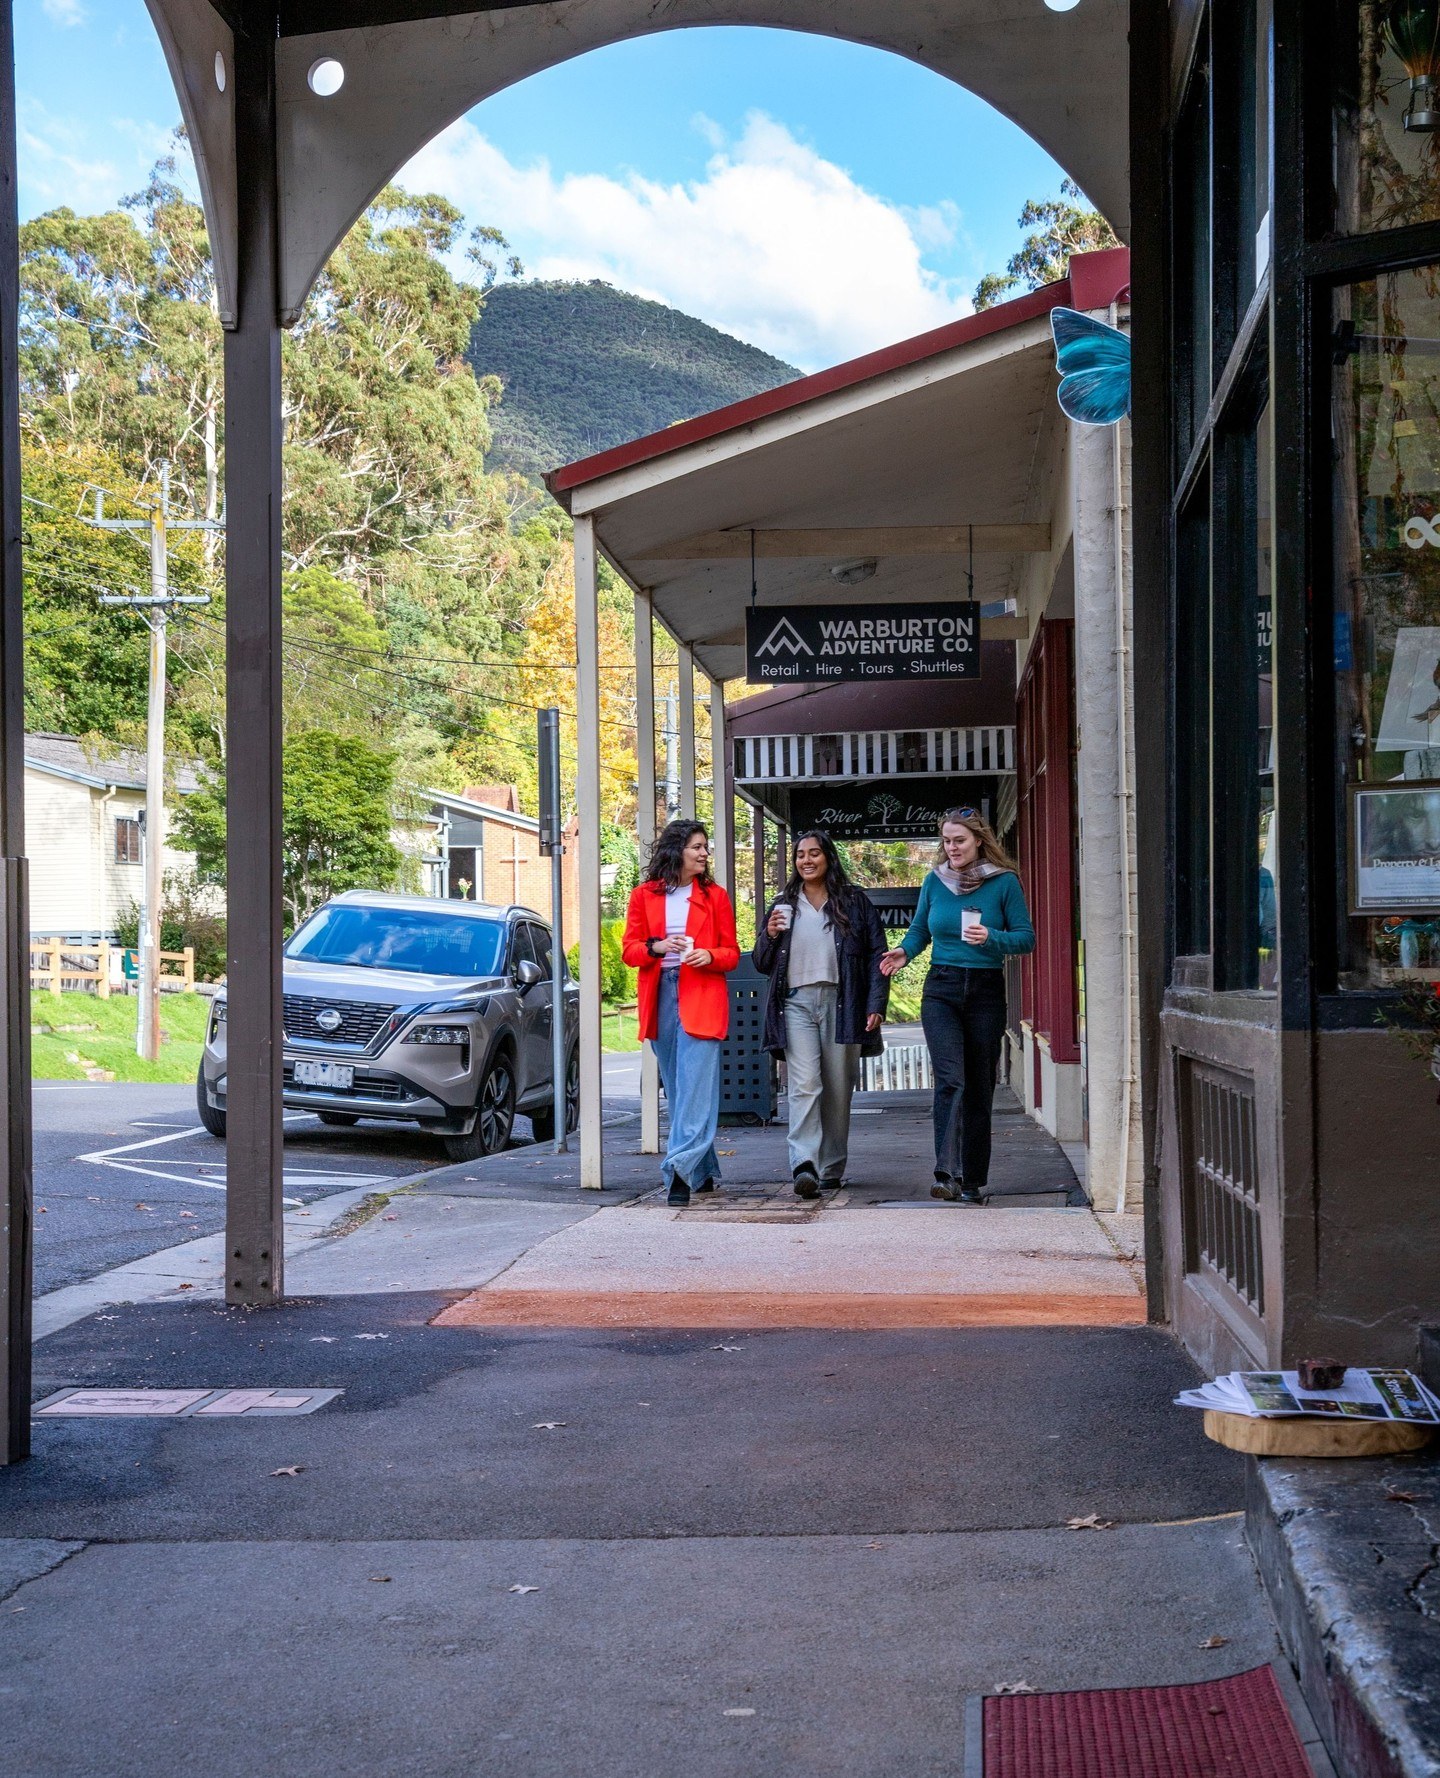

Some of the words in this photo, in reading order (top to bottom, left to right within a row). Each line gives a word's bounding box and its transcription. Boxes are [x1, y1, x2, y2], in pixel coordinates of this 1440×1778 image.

[818, 617, 974, 639] WARBURTON
[819, 638, 935, 656] ADVENTURE
[942, 637, 974, 653] CO.
[761, 662, 799, 676] Retail
[815, 663, 842, 675] Hire
[858, 661, 894, 675] Tours
[910, 658, 965, 673] Shuttles
[815, 807, 863, 824] River
[797, 828, 831, 837] CE
[876, 908, 917, 925] WIN
